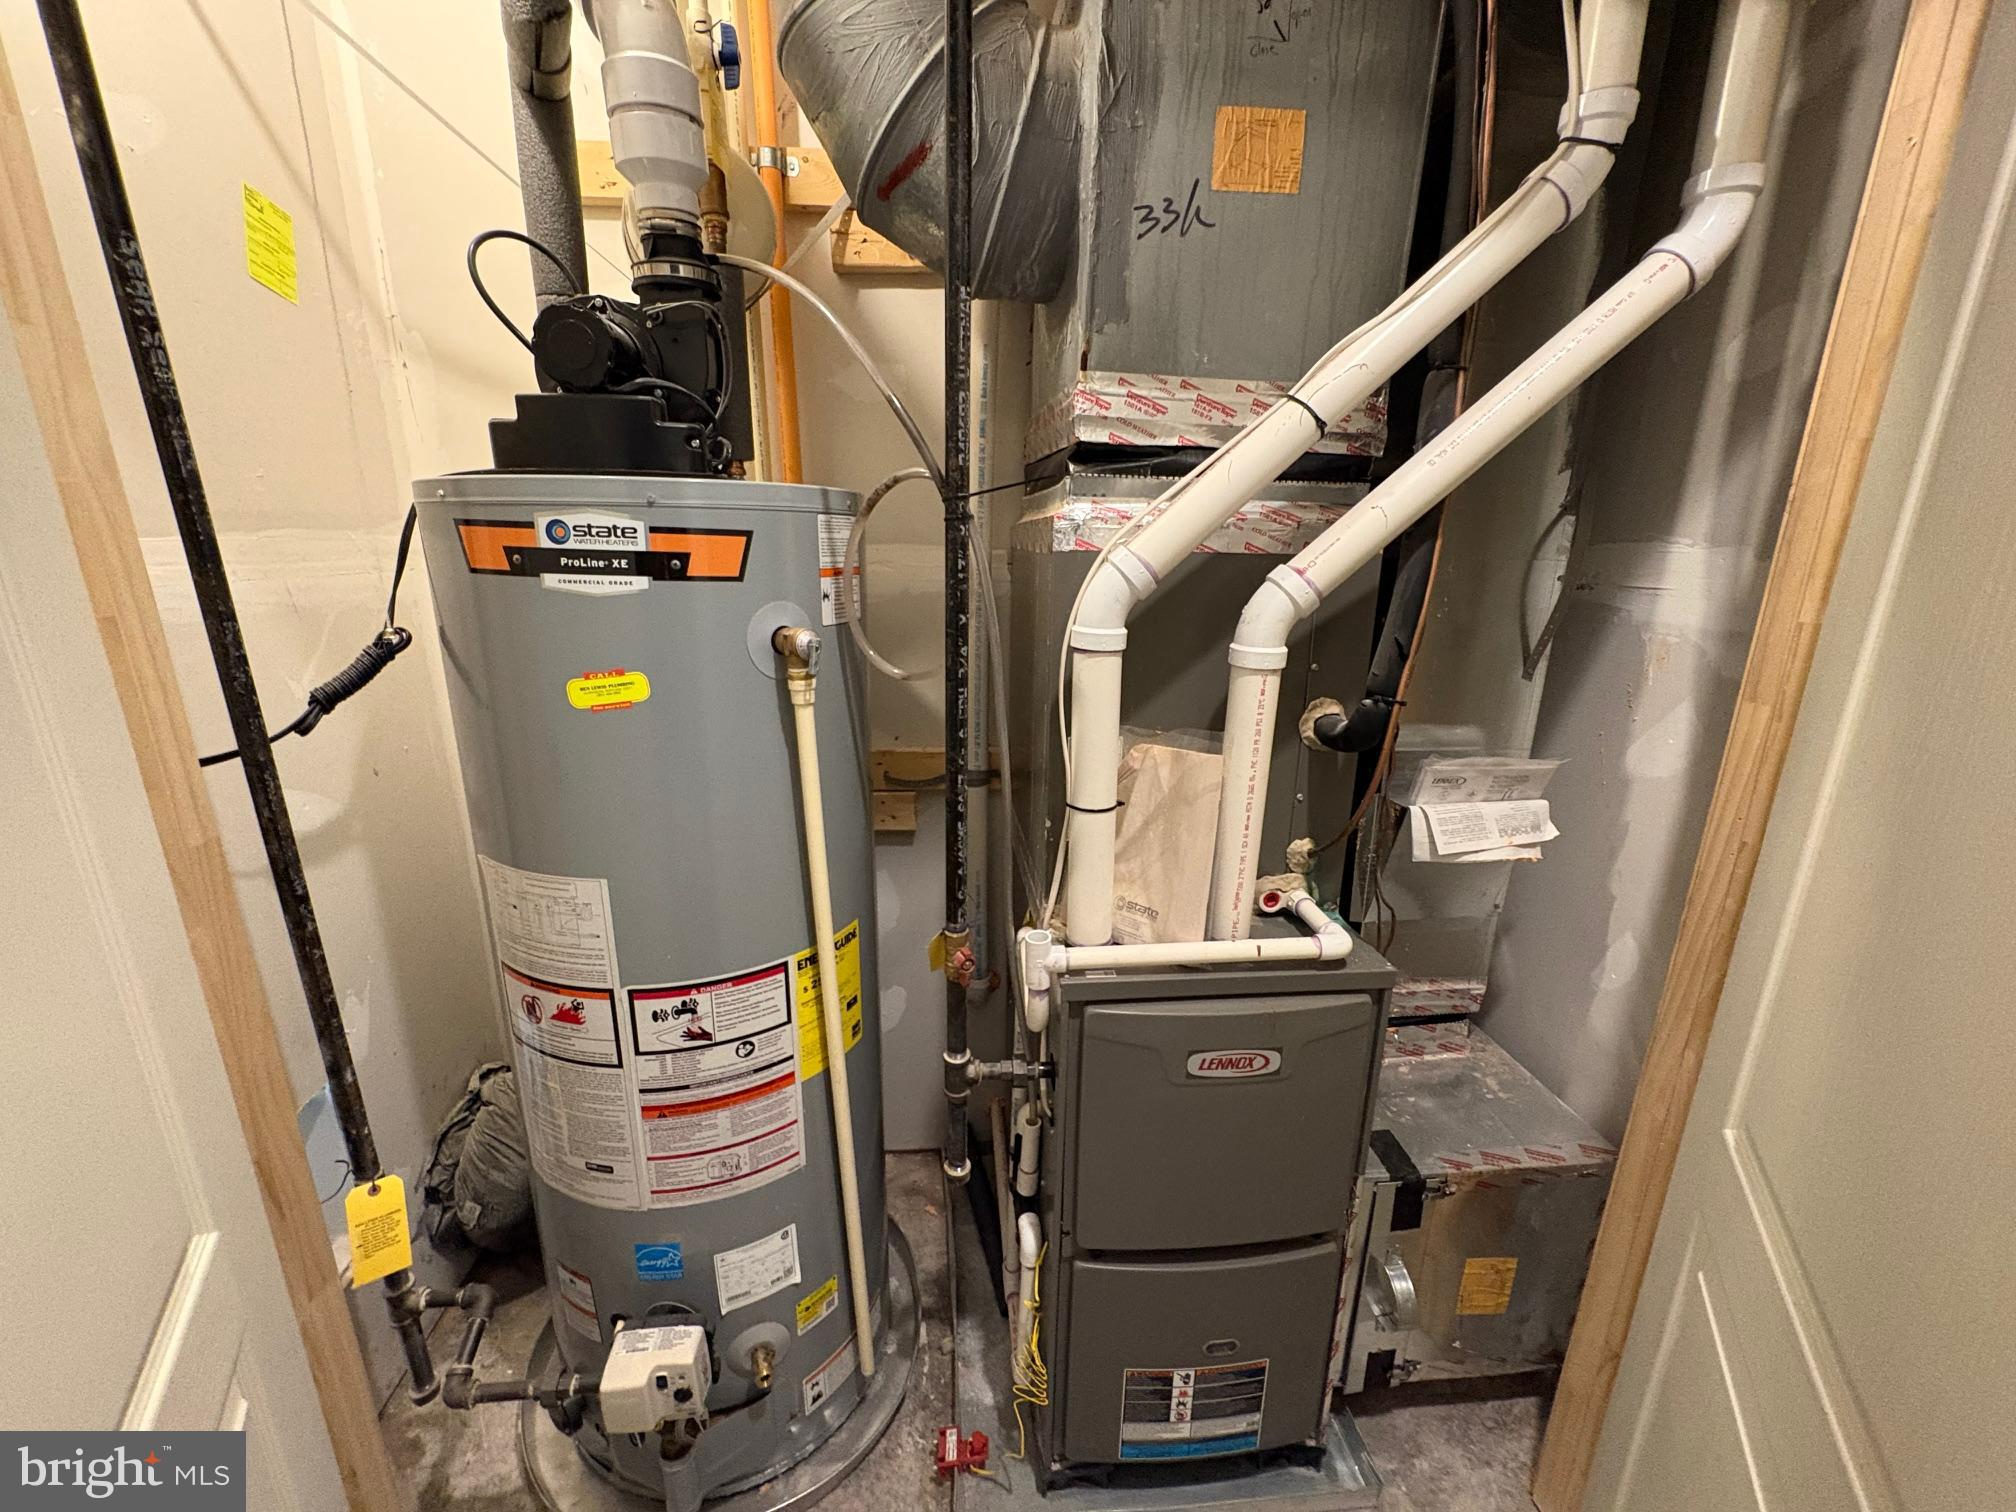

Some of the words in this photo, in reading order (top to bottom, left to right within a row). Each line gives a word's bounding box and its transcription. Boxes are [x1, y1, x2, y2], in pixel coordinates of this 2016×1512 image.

[572, 524, 639, 540] state
[600, 539, 639, 547] HEATERS
[612, 559, 629, 569] XE
[1125, 900, 1159, 919] state
[700, 982, 733, 993] DANGER
[1198, 1056, 1258, 1071] LENNOX
